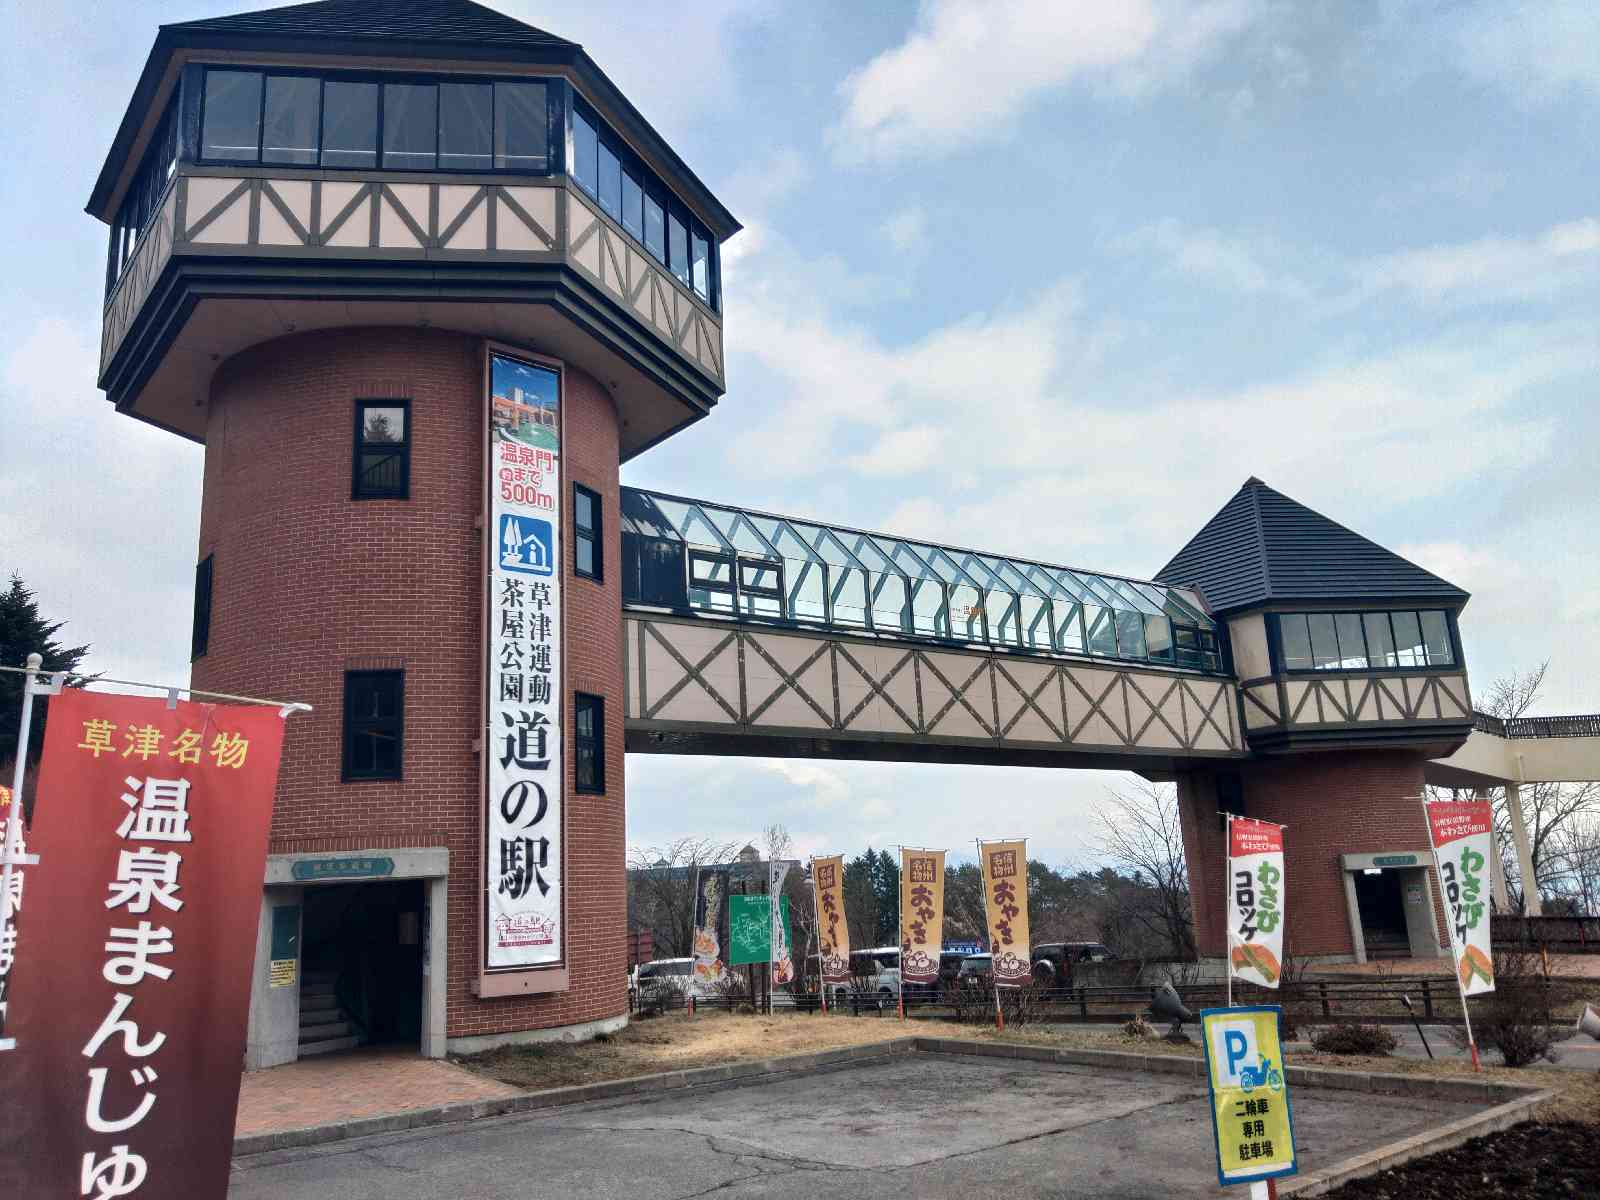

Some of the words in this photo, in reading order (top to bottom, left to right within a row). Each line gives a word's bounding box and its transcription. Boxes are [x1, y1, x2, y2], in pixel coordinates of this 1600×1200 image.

[500, 443, 552, 471] 温泉門
[501, 482, 553, 509] 500m
[499, 577, 525, 704] 茶屋公園
[528, 580, 553, 706] 草津運動
[77, 718, 250, 770] 草津名物
[498, 710, 552, 899] 道の駅
[909, 884, 935, 945] おやき
[993, 879, 1019, 945] おやき
[1235, 869, 1257, 941] コロッケ
[1257, 860, 1281, 933] わさび
[1441, 861, 1467, 945] コロッケ
[1460, 846, 1485, 930] わさび
[1224, 1030, 1248, 1076] P
[1235, 1098, 1270, 1118] 二輪車
[1242, 1121, 1265, 1138] 専用
[1238, 1141, 1275, 1161] 駐車場
